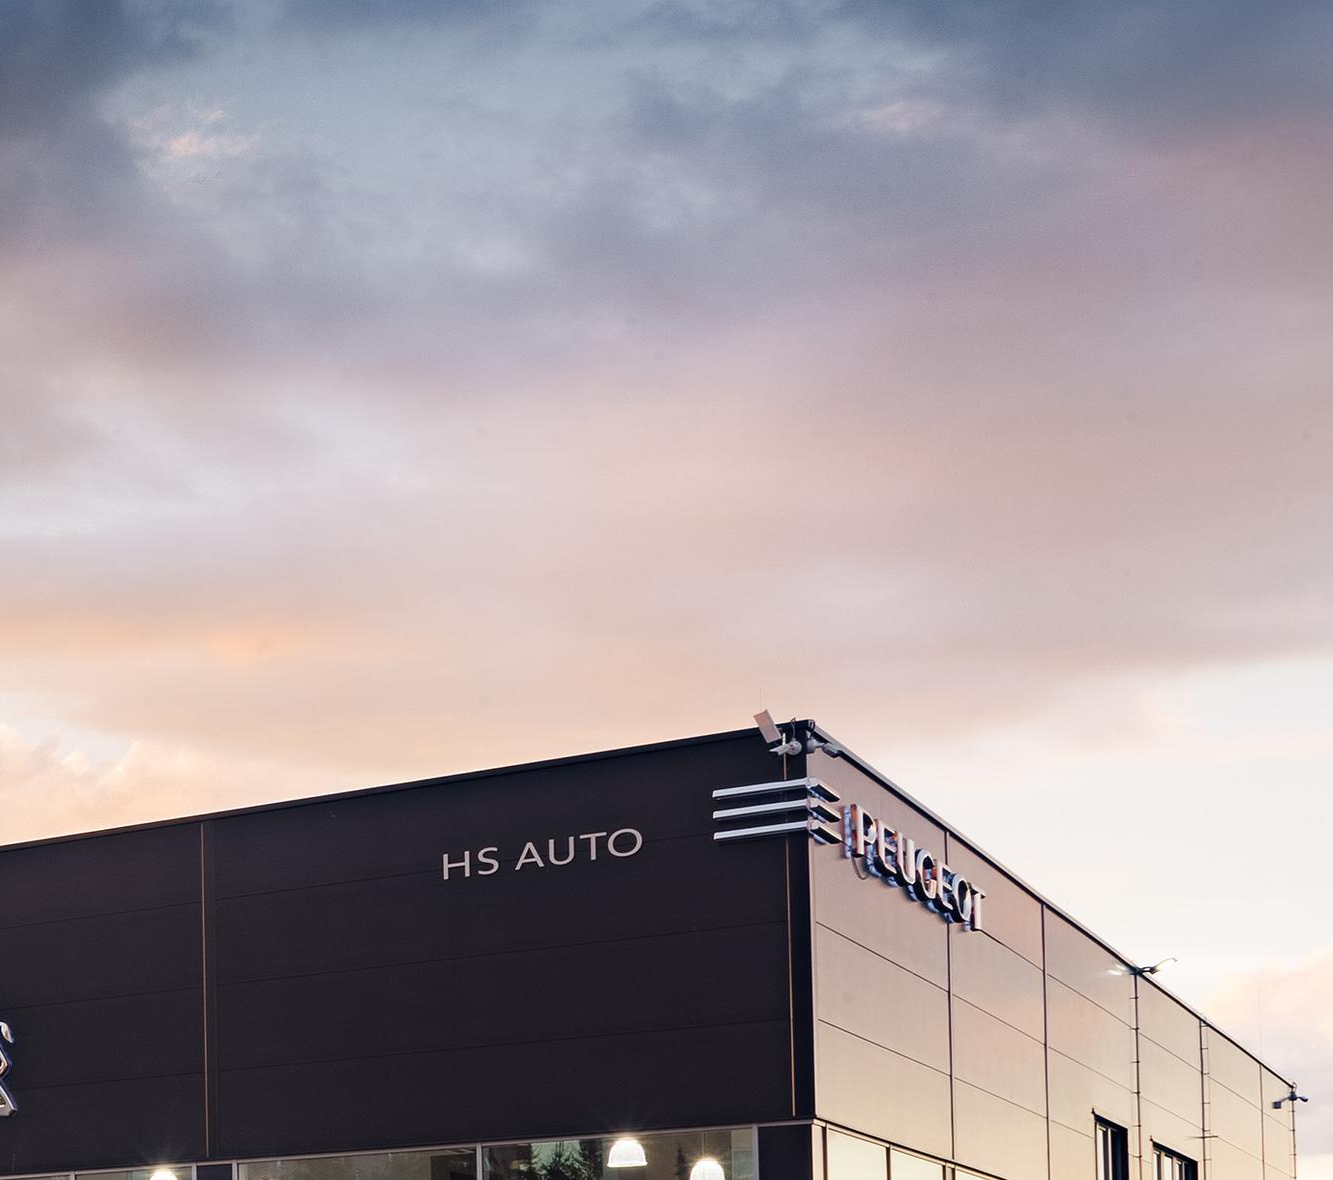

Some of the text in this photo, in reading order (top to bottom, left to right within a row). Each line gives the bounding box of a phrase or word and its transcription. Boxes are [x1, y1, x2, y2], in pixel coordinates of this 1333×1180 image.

[442, 828, 643, 880] HS AUTO
[851, 804, 986, 931] PEUGEOT
